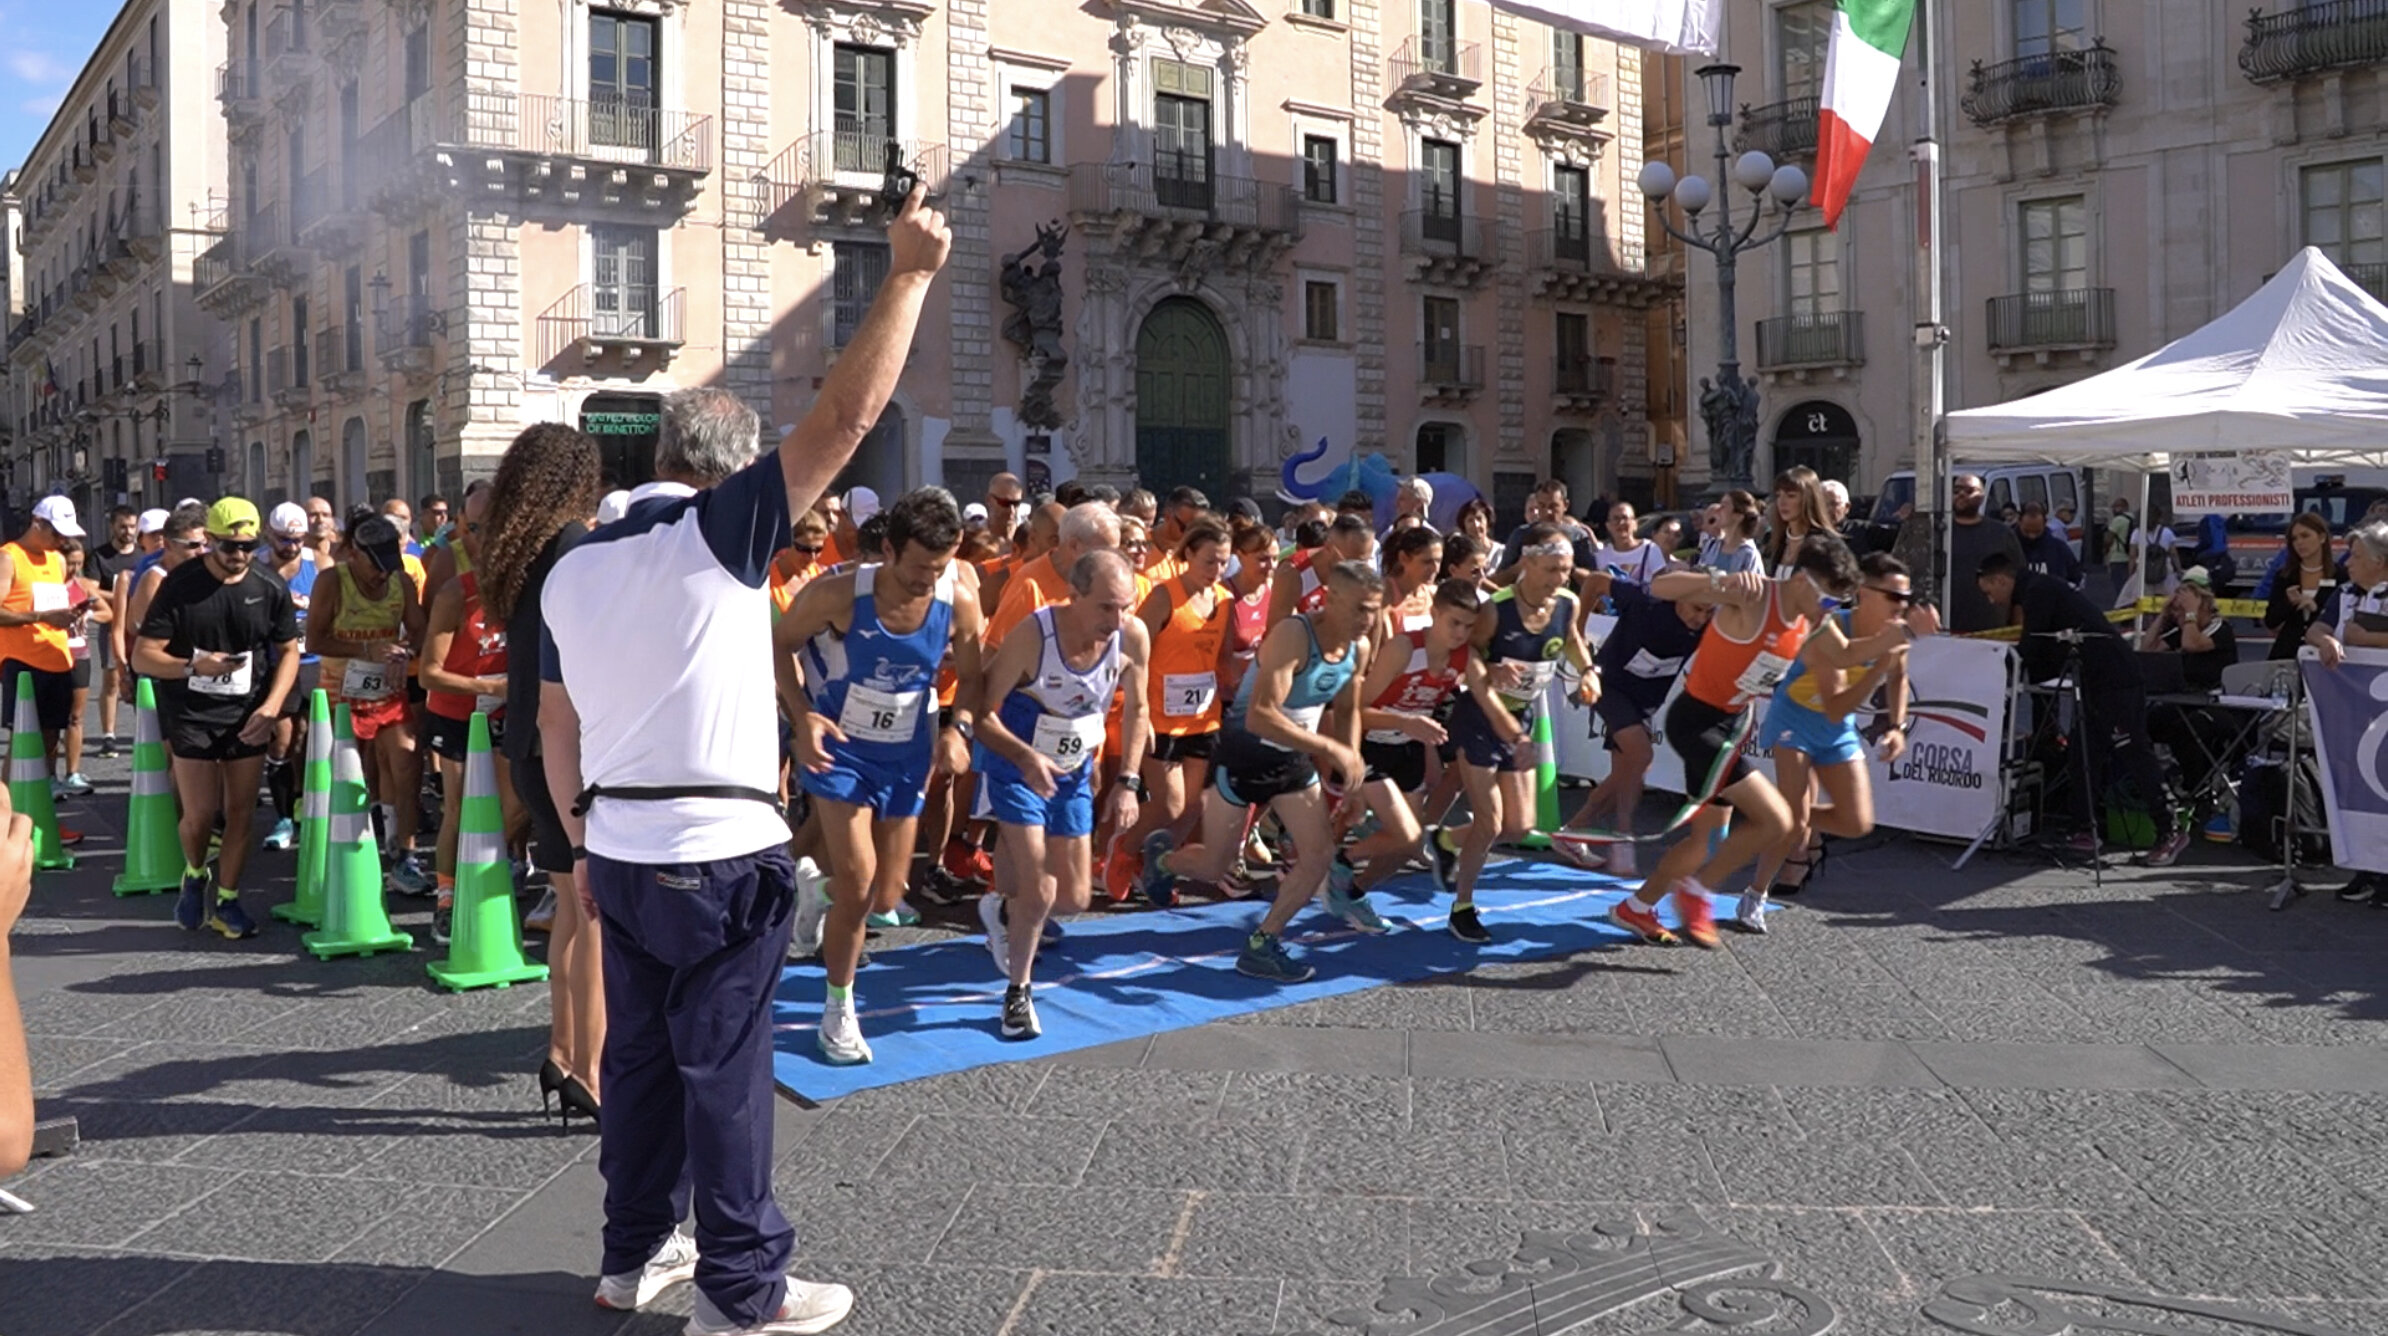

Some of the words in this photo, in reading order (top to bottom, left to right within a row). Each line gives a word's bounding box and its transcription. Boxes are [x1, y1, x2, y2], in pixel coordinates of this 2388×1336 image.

[586, 423, 601, 434] OF
[602, 424, 655, 435] BENETTON
[2176, 494, 2206, 507] ATLETI
[2208, 493, 2290, 507] PROFESSIONISTI
[362, 676, 381, 690] 63
[1184, 688, 1200, 705] 21
[872, 710, 895, 729] 16
[1057, 737, 1082, 755] 59
[1912, 741, 1973, 775] CORSA
[1903, 762, 1925, 781] DEL
